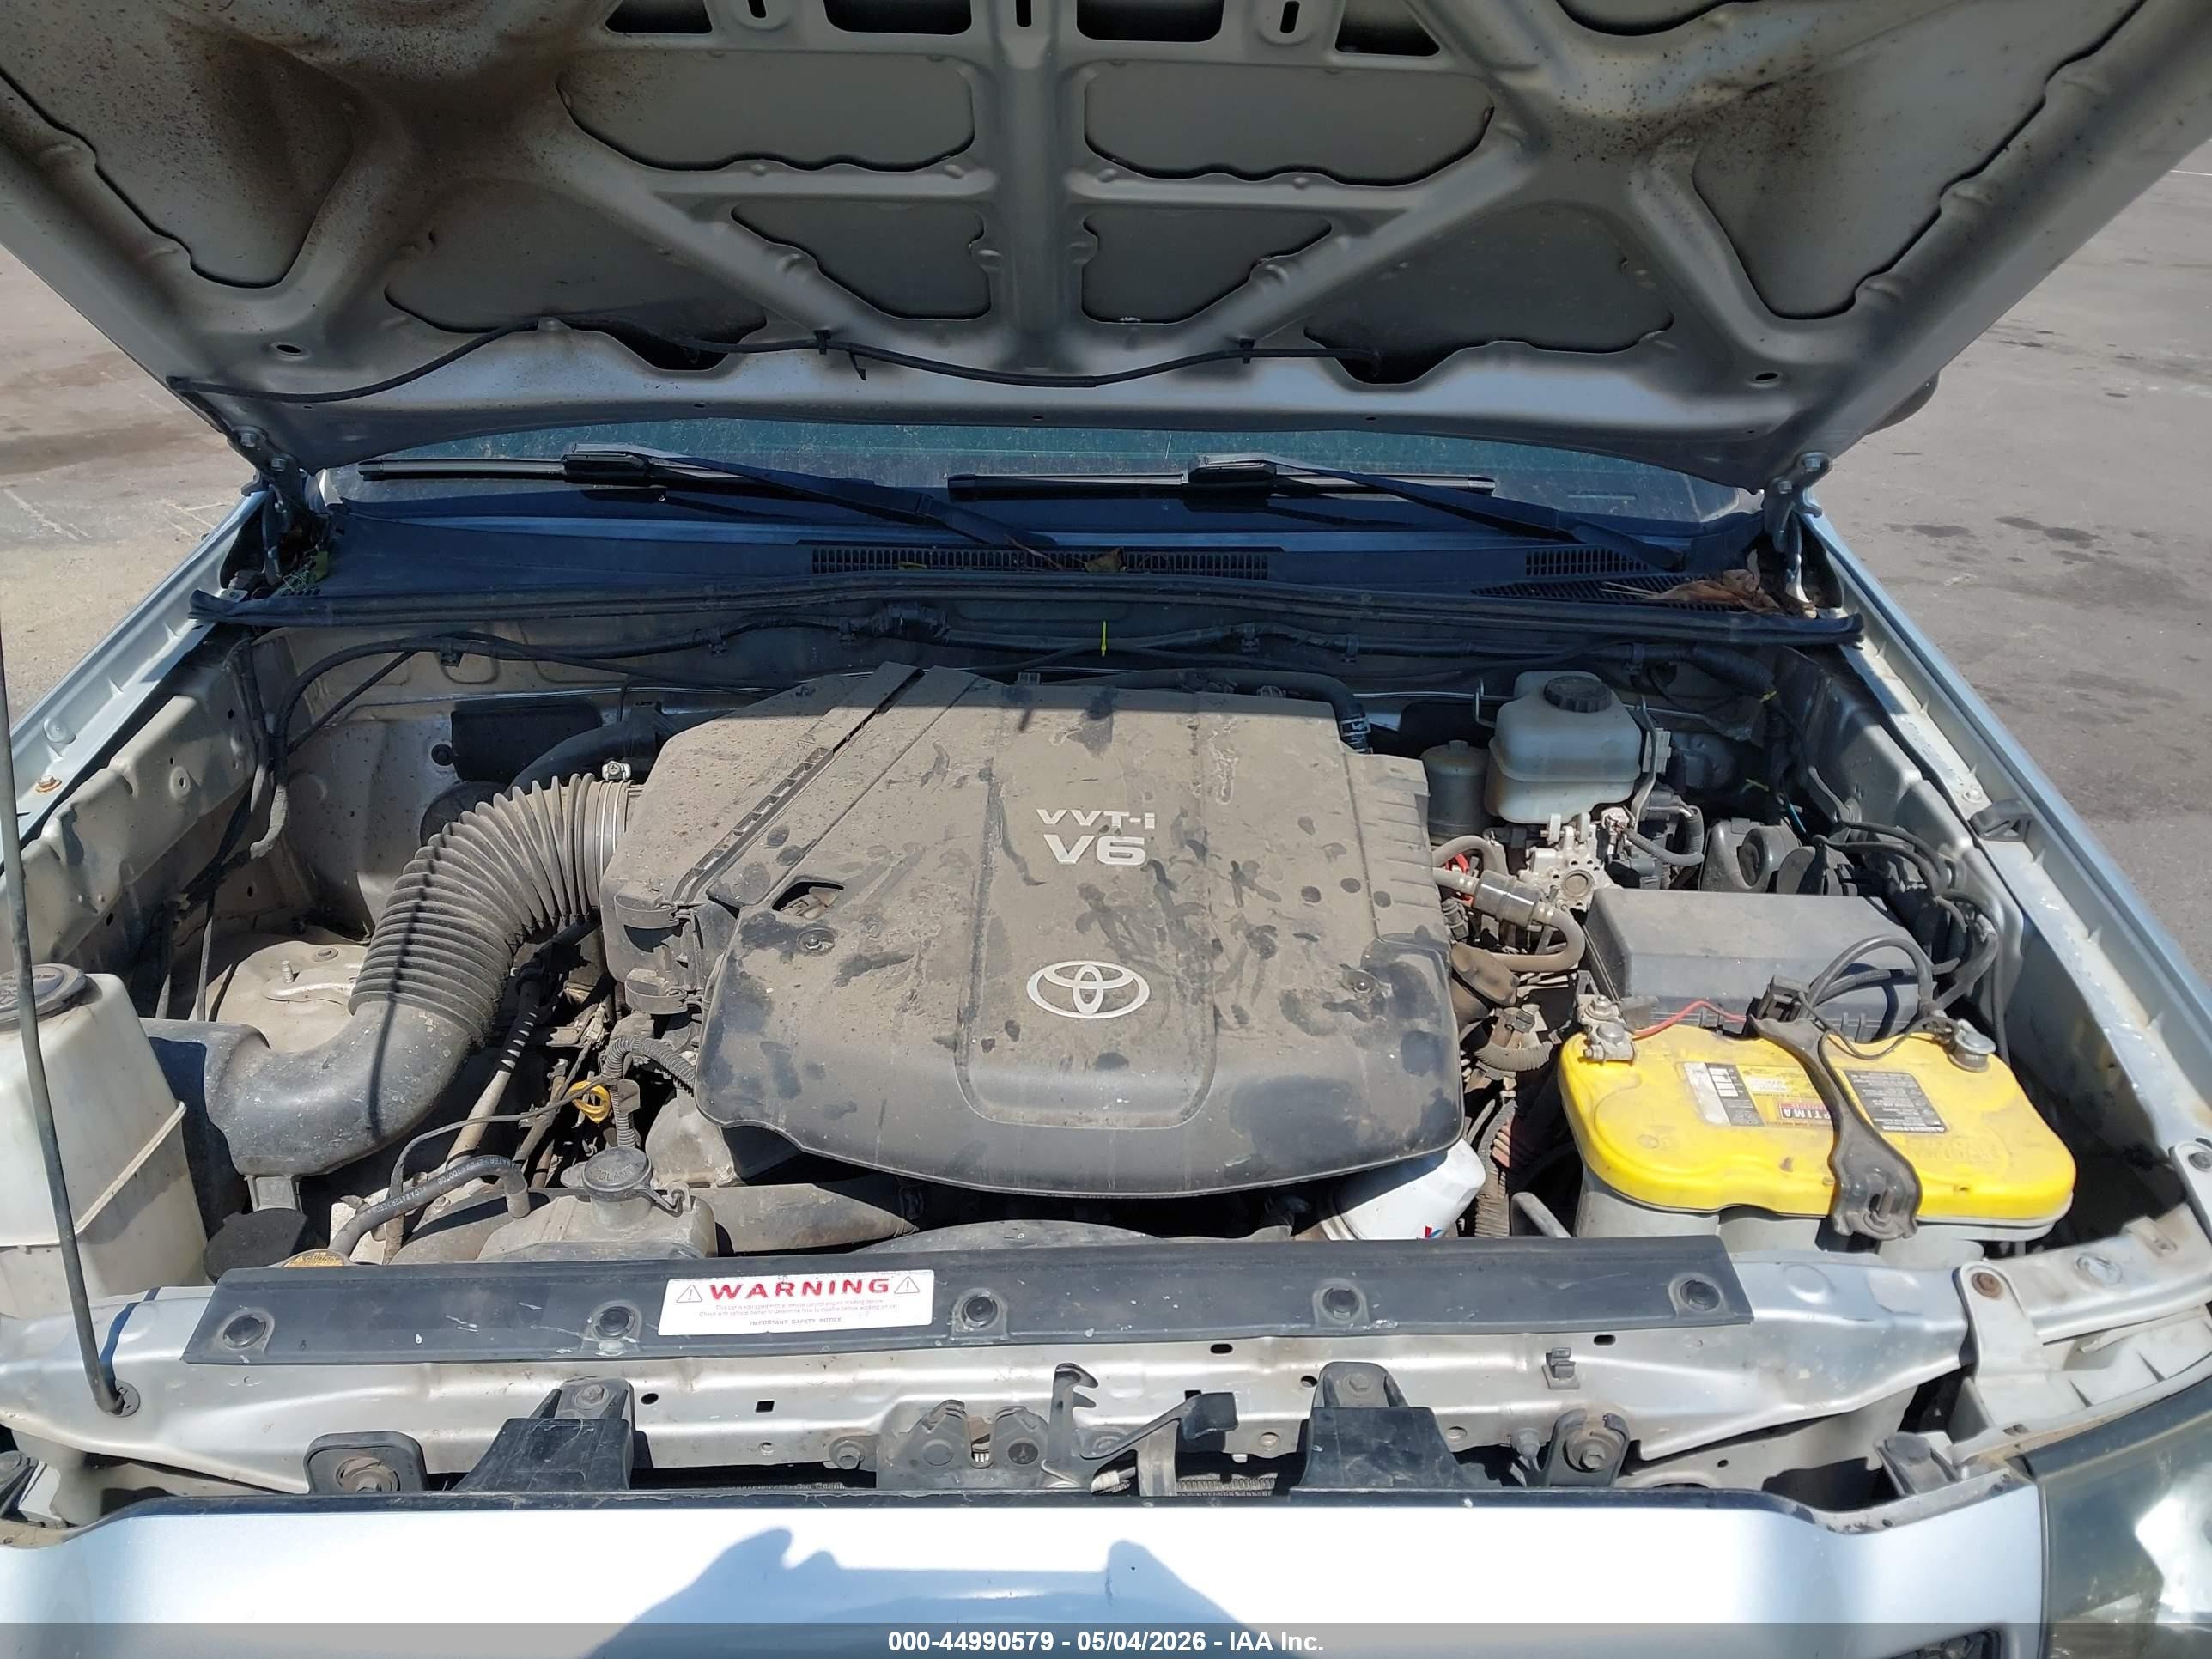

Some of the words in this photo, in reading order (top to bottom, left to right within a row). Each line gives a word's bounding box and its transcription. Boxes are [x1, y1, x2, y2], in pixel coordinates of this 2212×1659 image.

[1036, 809, 1155, 830] VVT-i
[1043, 834, 1146, 866] V6
[1783, 1108, 1831, 1120] PTIMA
[709, 1278, 890, 1300] WARNING
